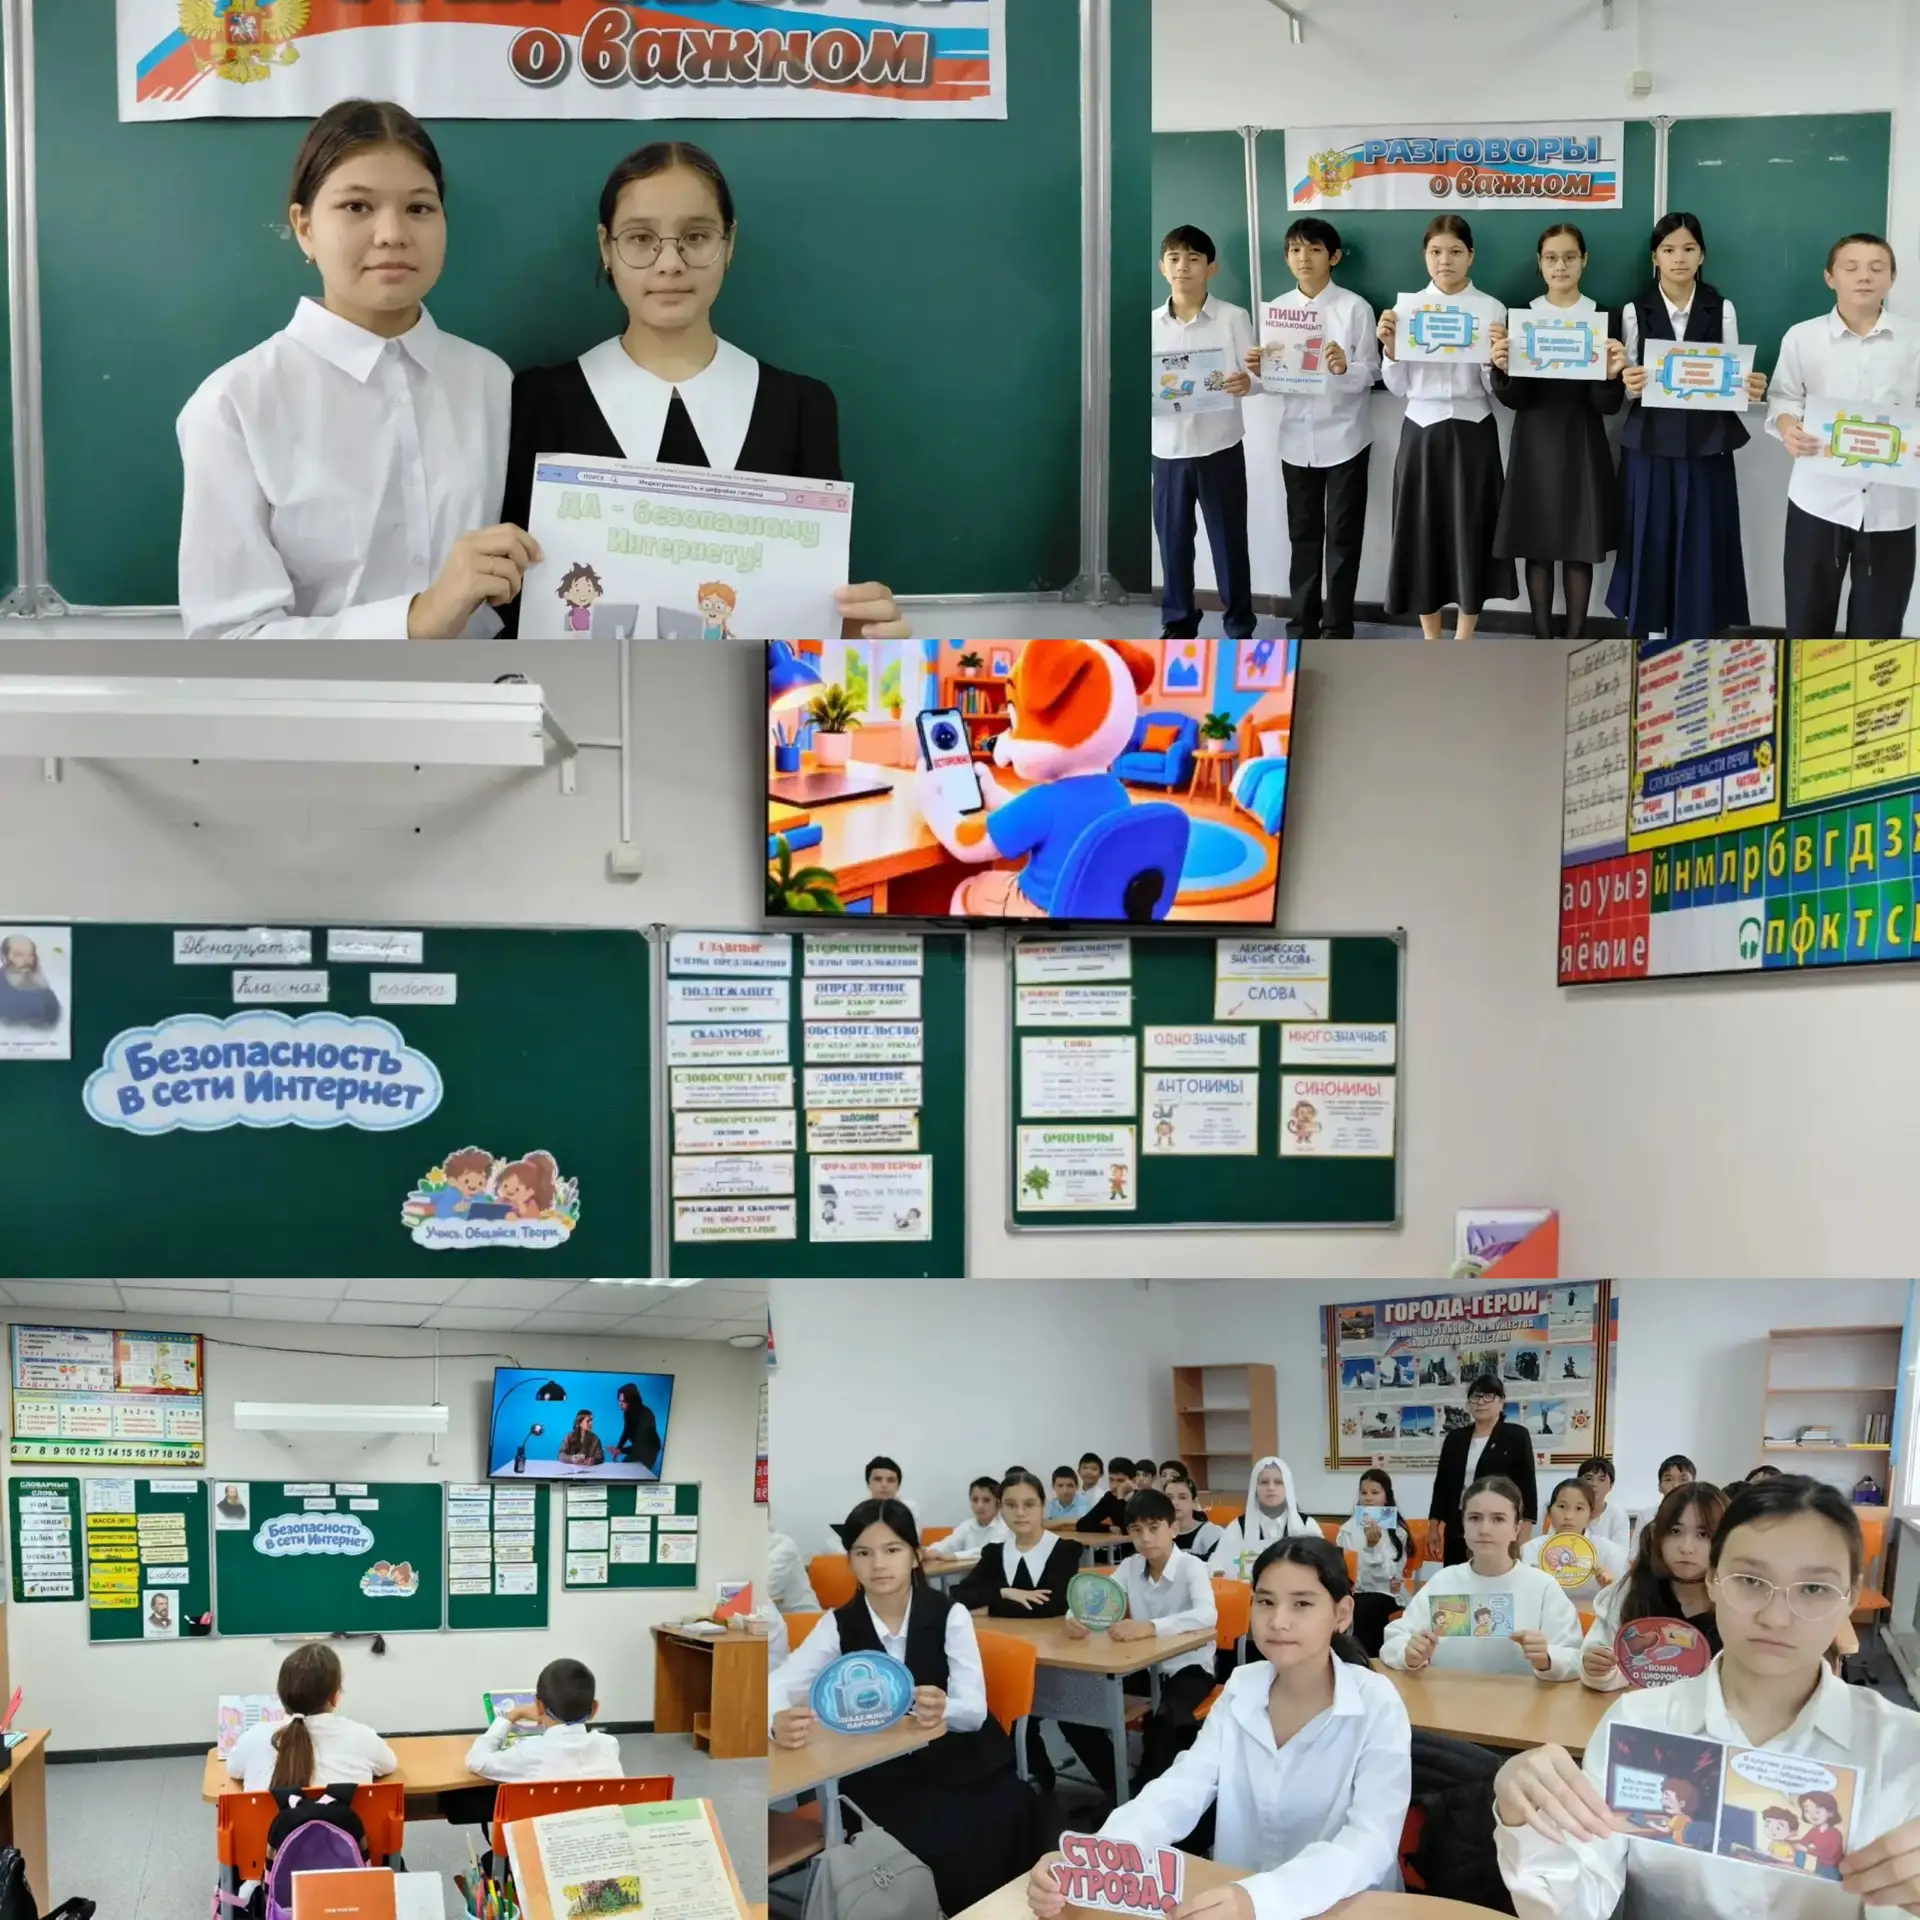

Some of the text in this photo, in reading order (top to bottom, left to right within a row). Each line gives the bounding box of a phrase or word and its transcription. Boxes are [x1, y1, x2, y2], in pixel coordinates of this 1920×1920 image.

[508, 7, 935, 88] о важном
[1363, 137, 1600, 165] РАЗГОВОРЫ
[1429, 166, 1593, 198] о важном
[1268, 306, 1318, 324] ПИШУТ
[557, 490, 603, 520] ДА
[633, 499, 821, 548] безопасному
[607, 525, 764, 573] Интернету!
[1699, 757, 1726, 777] ЧАСТИ
[1727, 750, 1750, 770] РЕЧИ
[1248, 986, 1296, 1000] СЛОВА
[1154, 1031, 1247, 1047] ОДНОЗНАЧНЫЕ
[1288, 1029, 1388, 1046] МНОГОЗНАЧНЫЕ
[124, 1040, 402, 1082] Безопасность
[152, 1070, 235, 1110] сети
[243, 1069, 424, 1112] Интернет
[1156, 1078, 1244, 1095] АНТОНИМЫ
[1294, 1080, 1381, 1097] СИНОНИМЫ
[1043, 1133, 1114, 1144] ОМОНИМЫ
[1384, 1290, 1540, 1323] ГОРОДА-ГЕРОИ
[11, 1446, 200, 1459] 6 7 8 9 10 12 13 14 15 16 17 18 19 20
[20, 1481, 69, 1489] СЛОВАРНЫЕ
[268, 1522, 361, 1538] Безопасность
[277, 1535, 304, 1547] сети
[307, 1533, 368, 1549] Интернет
[1062, 1834, 1145, 1874] СТОП
